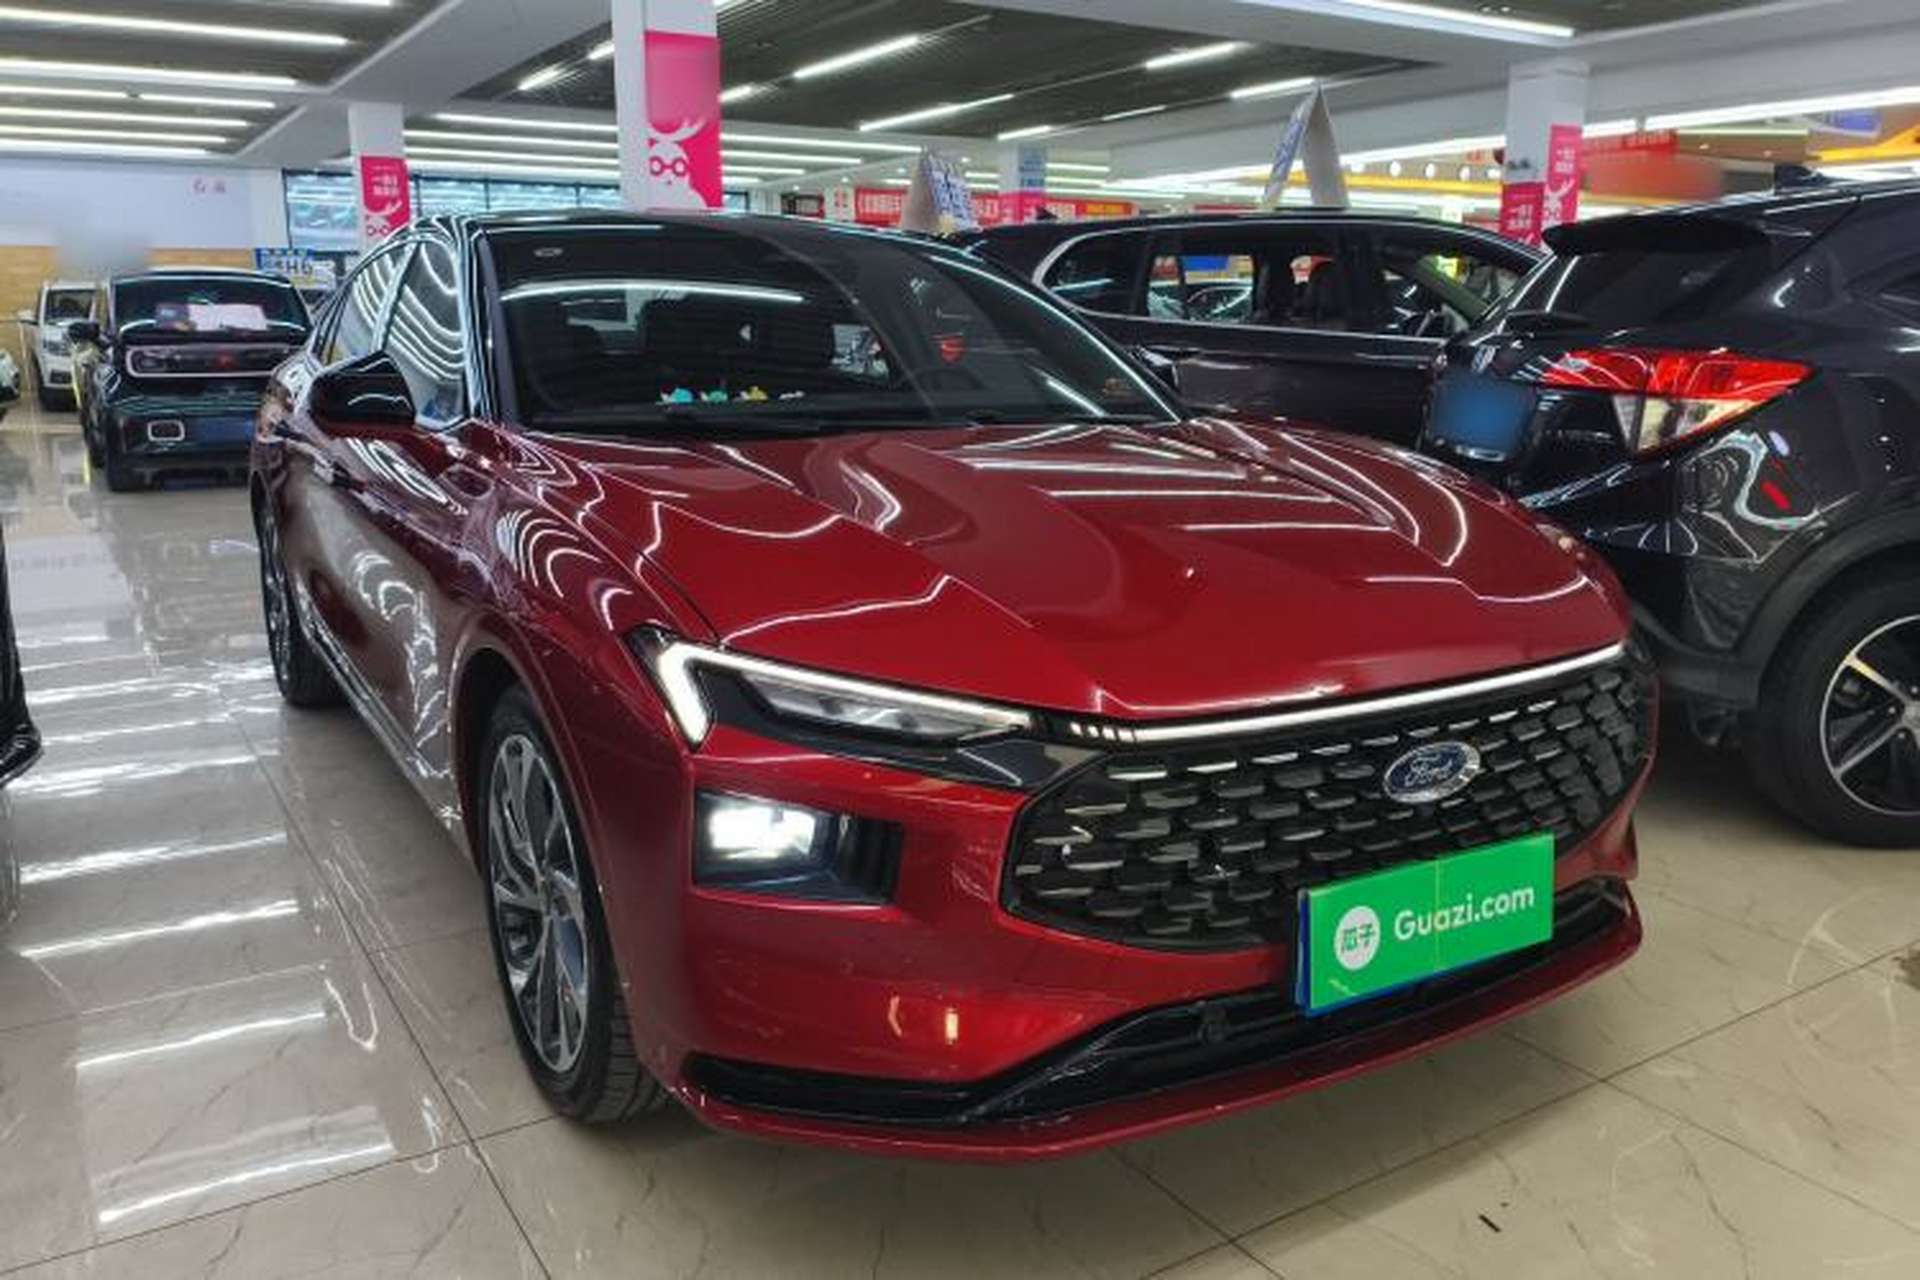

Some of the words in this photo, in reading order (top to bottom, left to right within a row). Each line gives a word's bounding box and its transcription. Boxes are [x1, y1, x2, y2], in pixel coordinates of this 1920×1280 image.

[1404, 754, 1455, 787] Ford
[1340, 923, 1376, 953] 瓜子
[1394, 887, 1535, 940] Guazi.com
